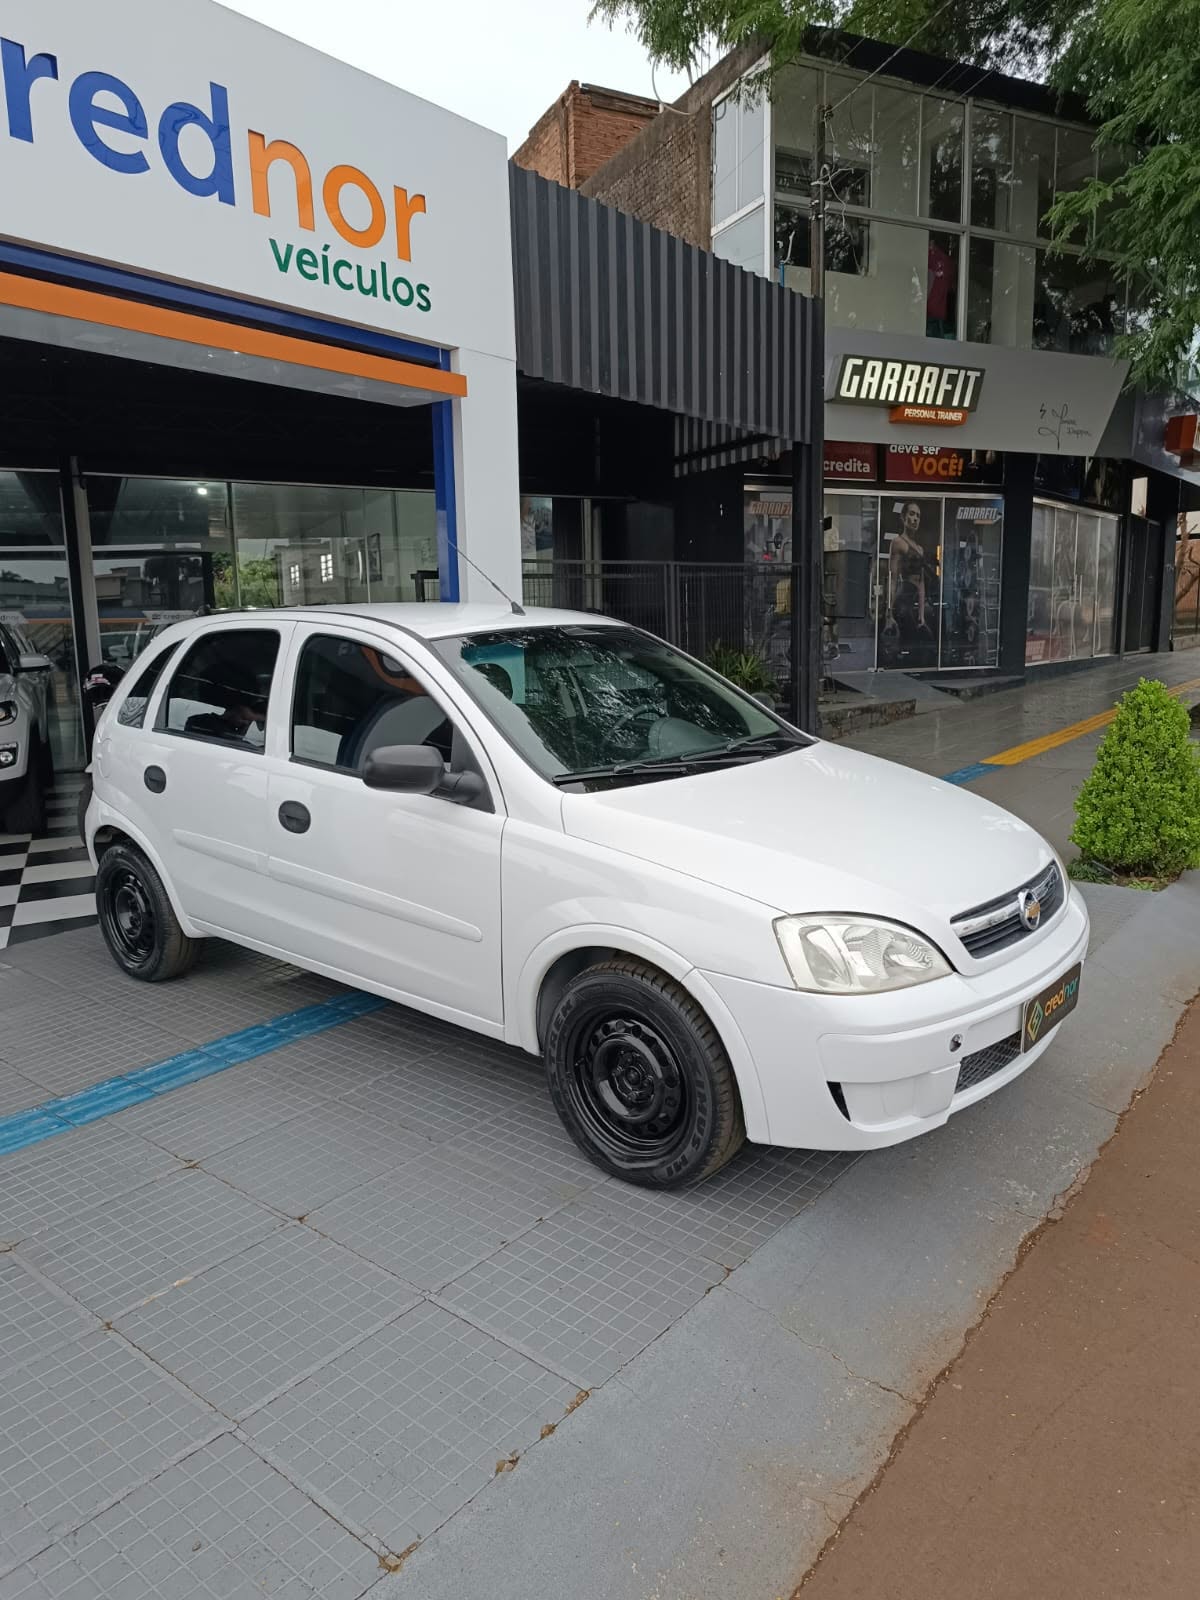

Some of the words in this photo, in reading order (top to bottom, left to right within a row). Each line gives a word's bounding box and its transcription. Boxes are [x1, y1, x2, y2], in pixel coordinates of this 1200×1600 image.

[269, 238, 432, 312] veículos
[839, 358, 981, 407] GARRAFIT
[904, 408, 936, 420] PERSONAL
[937, 411, 963, 422] TRAINER
[922, 445, 940, 456] ser
[911, 453, 964, 477] VOCÊ!
